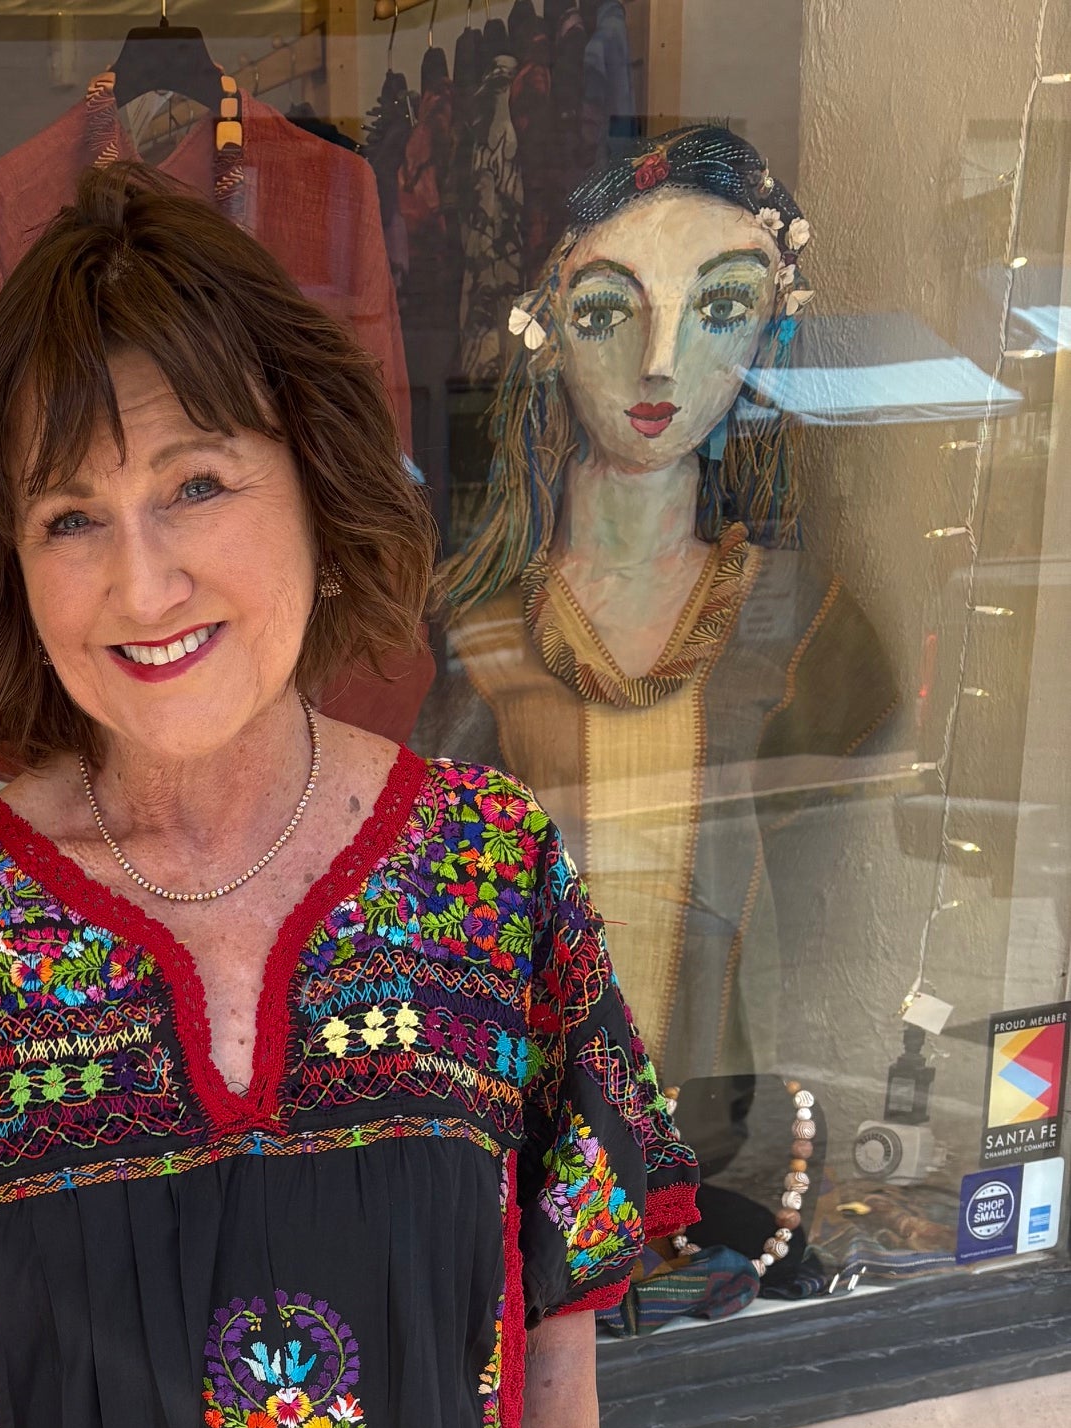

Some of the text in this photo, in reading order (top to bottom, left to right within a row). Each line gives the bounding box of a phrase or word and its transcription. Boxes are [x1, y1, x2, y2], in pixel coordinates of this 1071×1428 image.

[994, 1012, 1067, 1033] PROUD MEMBER
[985, 1123, 1057, 1150] SANTA FE
[984, 1140, 1057, 1160] CHAMBER OF COMMERCE
[974, 1208, 1006, 1224] SMALL
[977, 1199, 1005, 1213] SHOP
